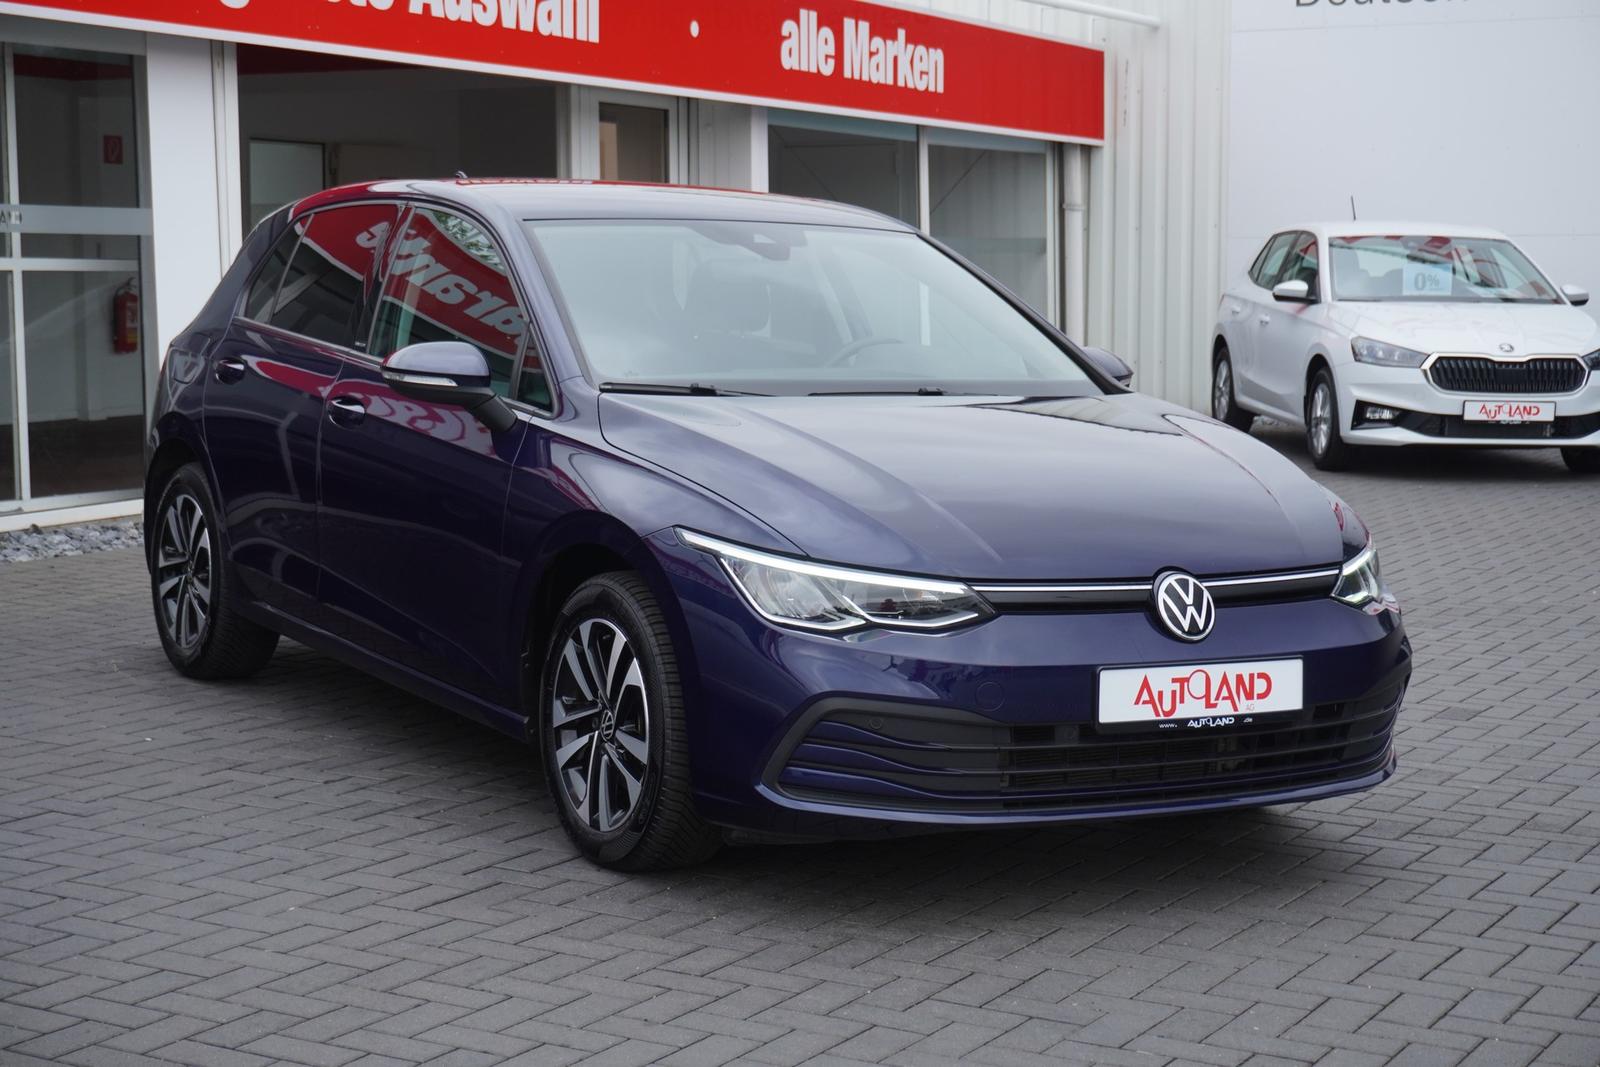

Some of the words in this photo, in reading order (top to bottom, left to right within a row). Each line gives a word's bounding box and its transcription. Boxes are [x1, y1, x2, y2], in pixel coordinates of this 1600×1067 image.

[408, 0, 600, 43] wahl
[780, 8, 836, 77] alle
[843, 16, 945, 94] Marken
[1414, 272, 1441, 291] 0%
